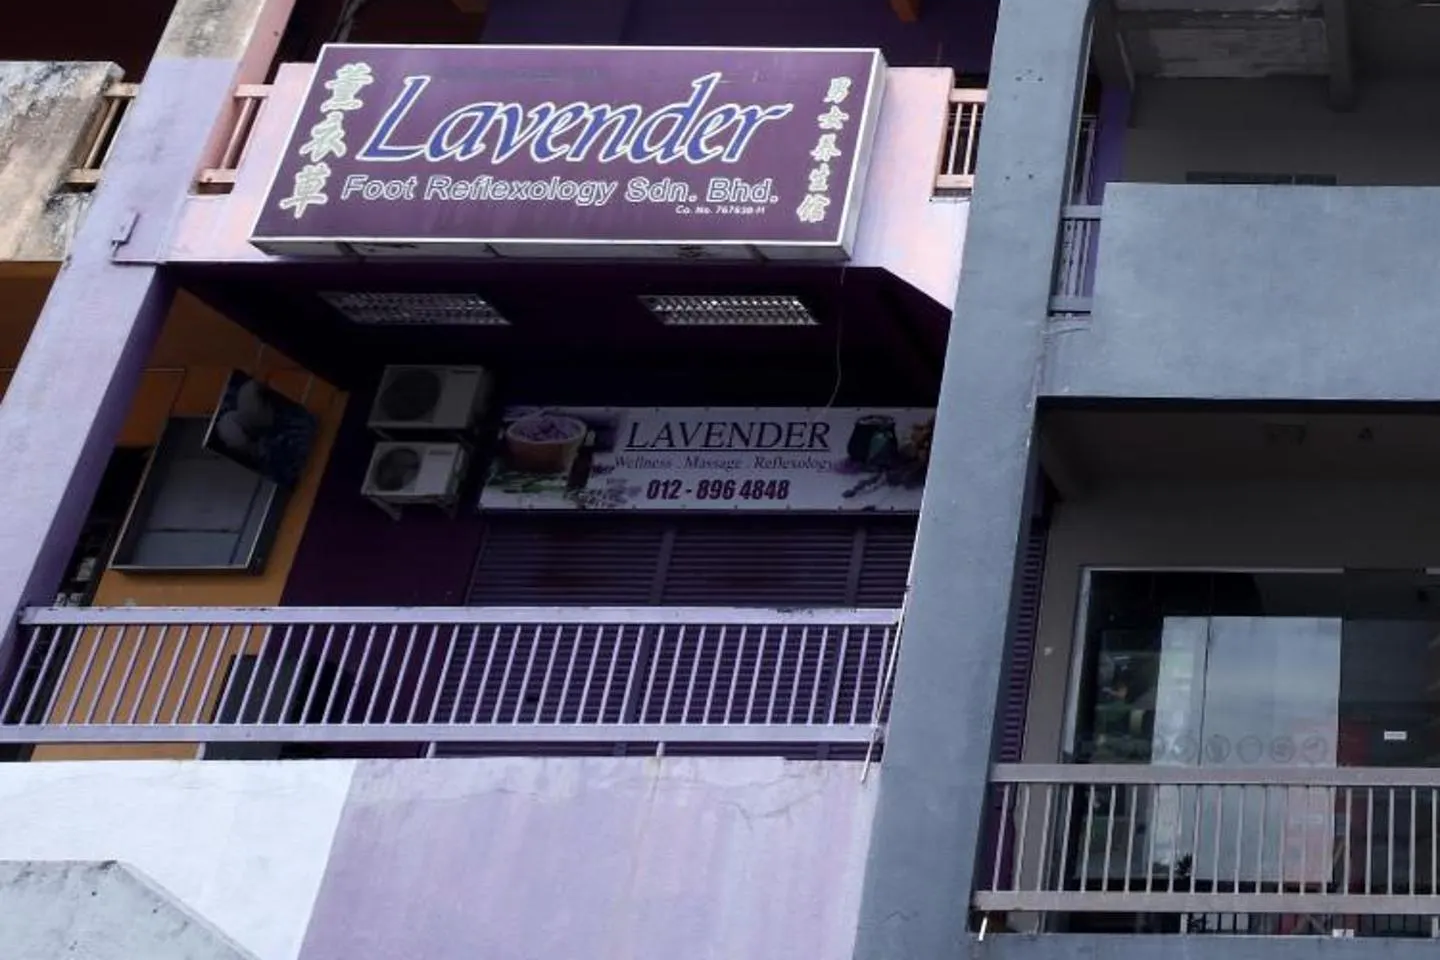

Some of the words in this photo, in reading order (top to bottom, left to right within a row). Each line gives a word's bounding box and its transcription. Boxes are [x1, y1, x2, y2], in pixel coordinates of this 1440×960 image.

[355, 71, 795, 164] Lavender
[341, 174, 418, 201] Foot
[424, 175, 619, 206] Reflexology
[624, 176, 698, 203] Sdn.
[706, 177, 780, 204] Bhd.
[625, 421, 830, 449] LAVENDER
[614, 455, 673, 470] Wellness
[683, 454, 743, 472] Massage
[646, 479, 683, 500] 012
[696, 479, 736, 500] 896
[738, 479, 791, 500] 4848
